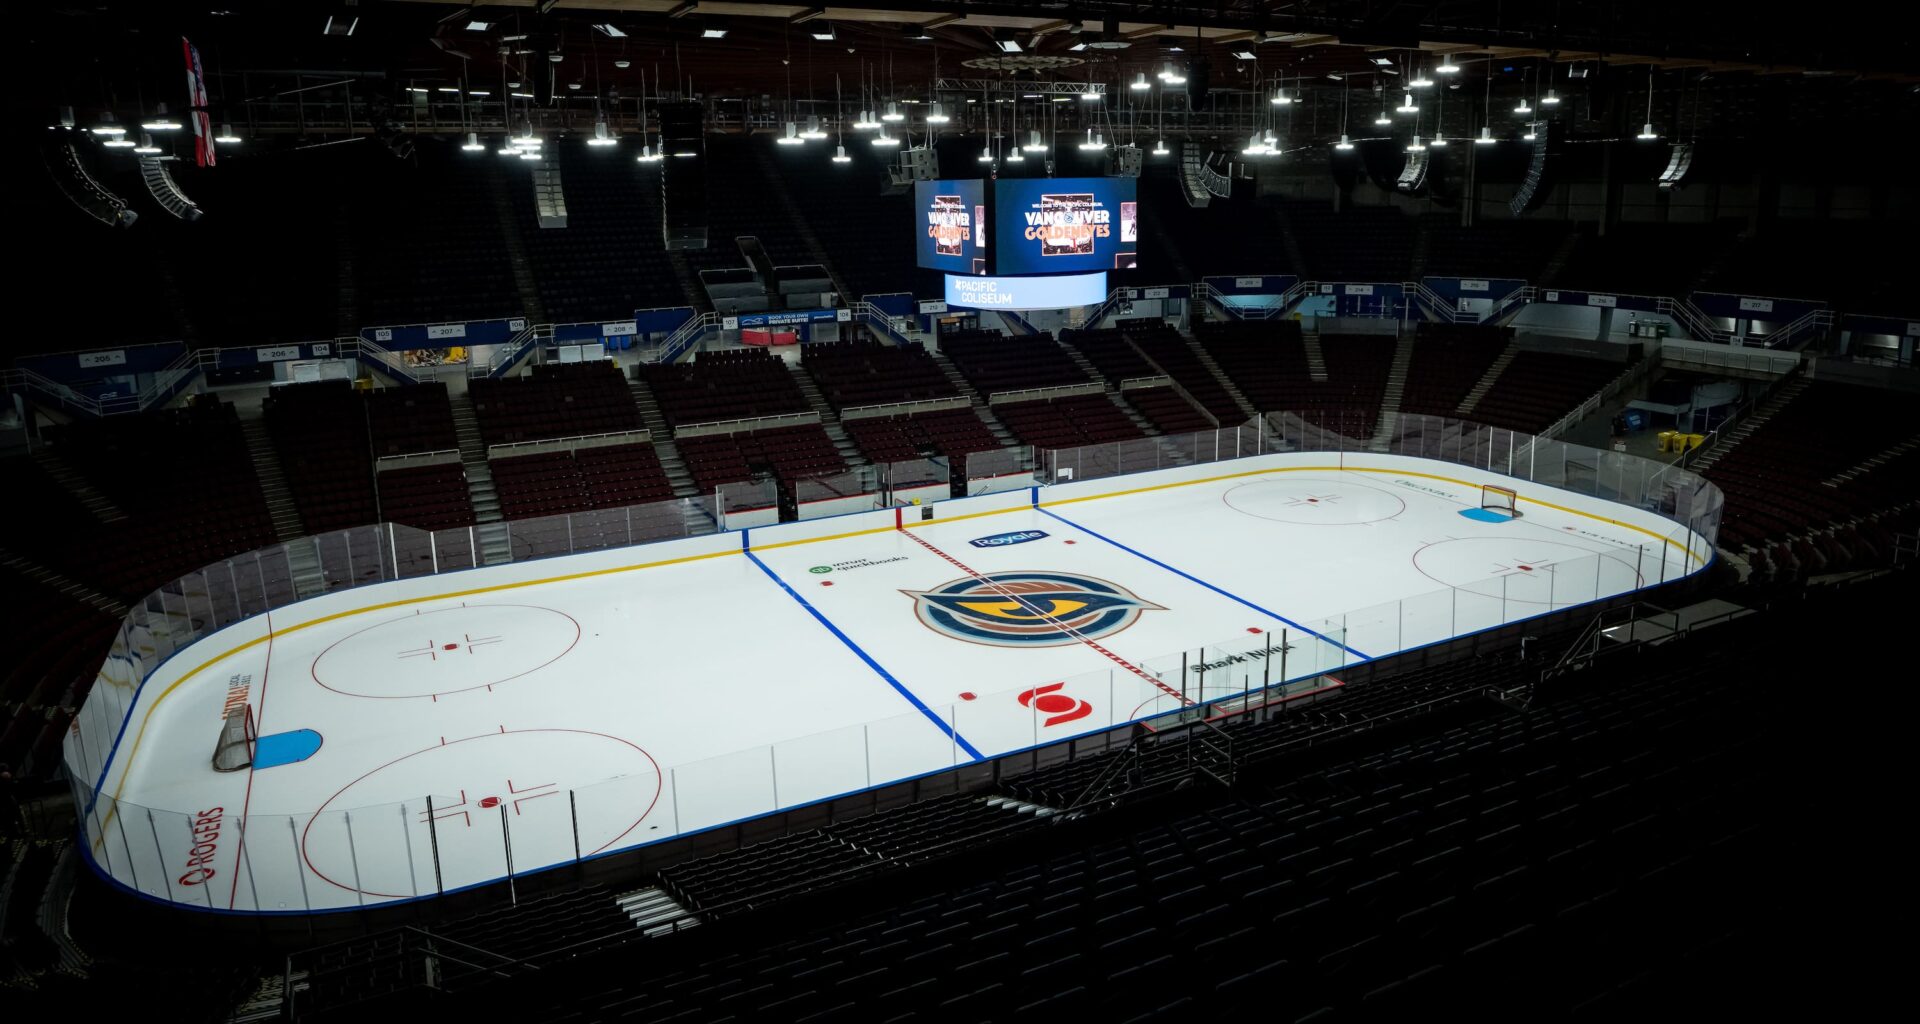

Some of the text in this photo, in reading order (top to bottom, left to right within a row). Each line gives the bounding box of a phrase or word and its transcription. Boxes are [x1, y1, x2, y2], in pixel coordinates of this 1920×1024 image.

[1025, 224, 1110, 240] GOLDENEYES
[961, 280, 997, 293] PACIFIC
[961, 292, 1012, 304] COLISEUM
[94, 355, 111, 363] 205
[974, 531, 1042, 547] Royale
[837, 556, 909, 572] quickbooks
[1190, 655, 1248, 674] Shark
[186, 806, 224, 867] ROGERS
